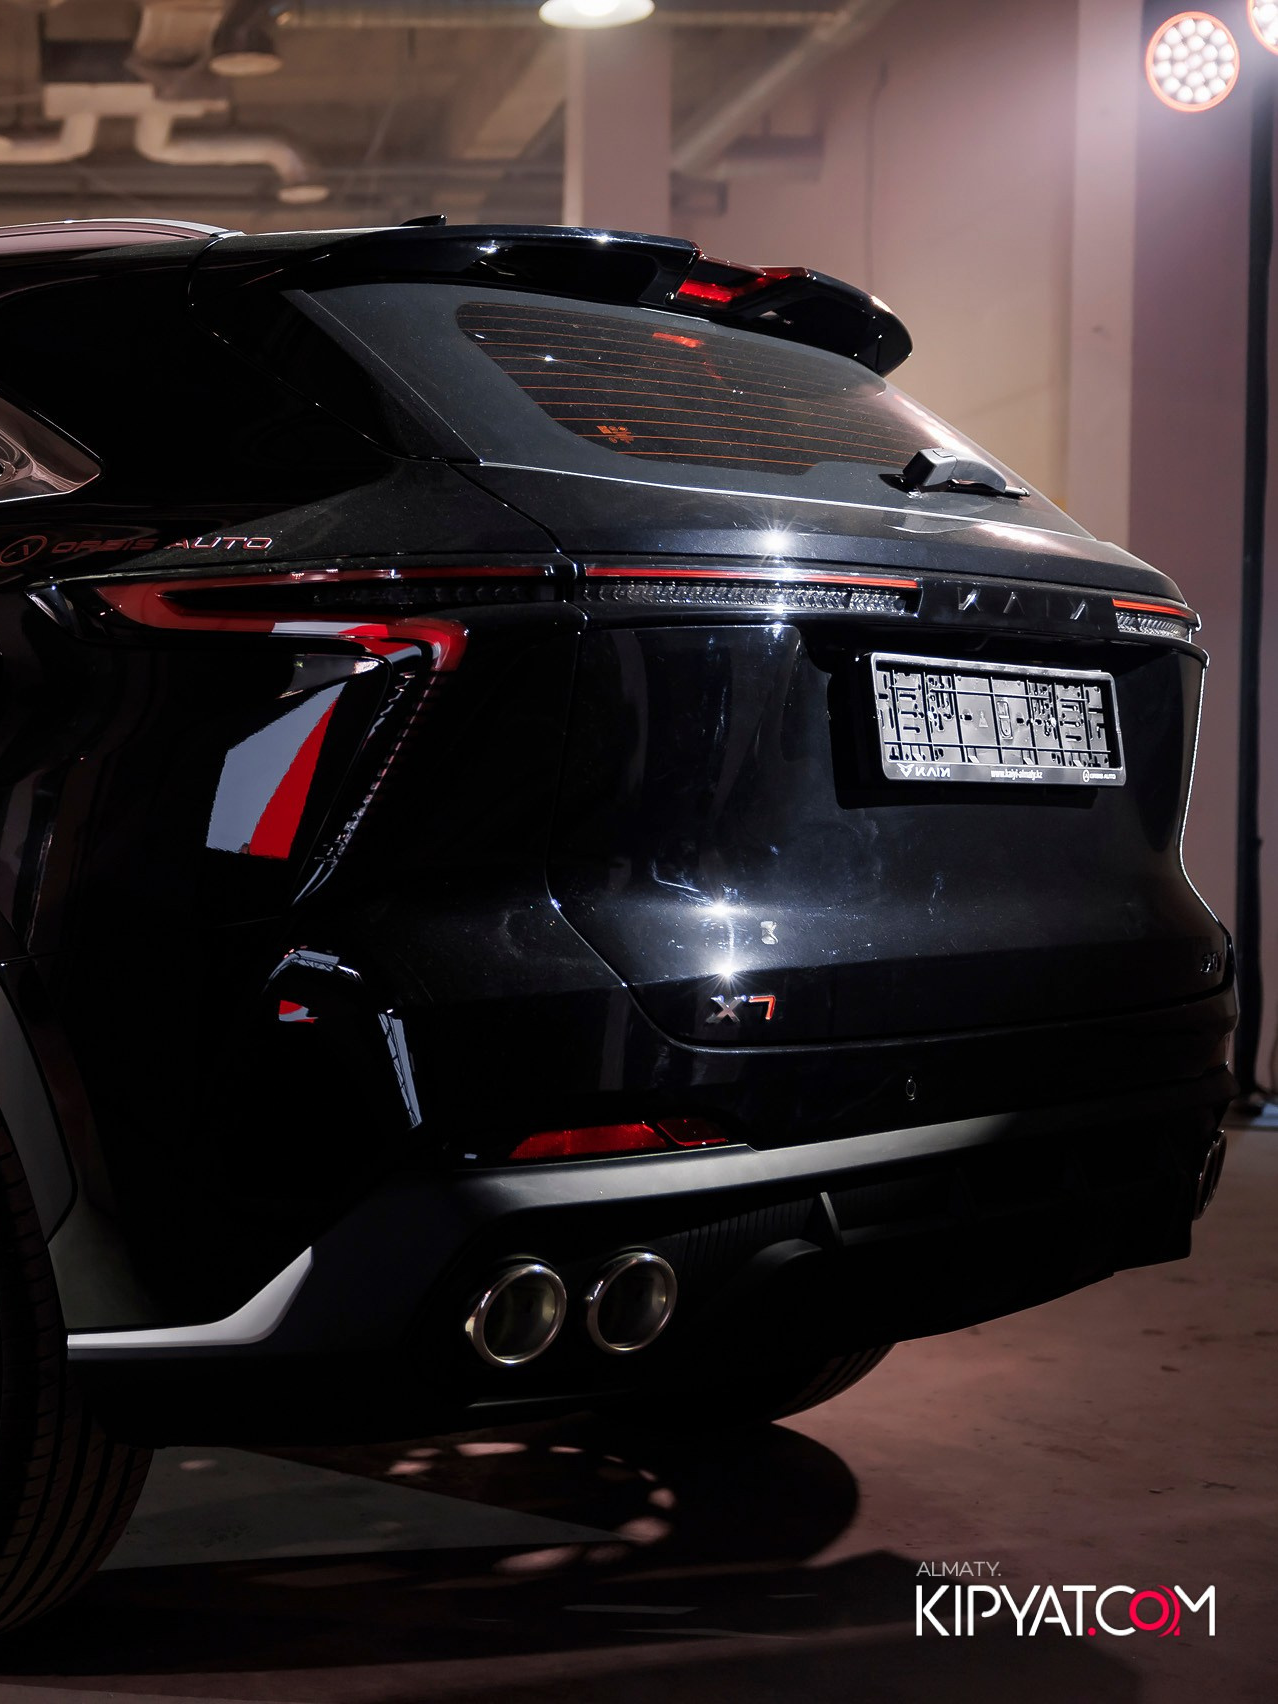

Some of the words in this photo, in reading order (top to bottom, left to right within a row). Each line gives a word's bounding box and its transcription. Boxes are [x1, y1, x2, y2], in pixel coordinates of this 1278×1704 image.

[51, 537, 160, 555] ORBIS
[163, 535, 274, 551] AUTO
[705, 994, 777, 1024] X7
